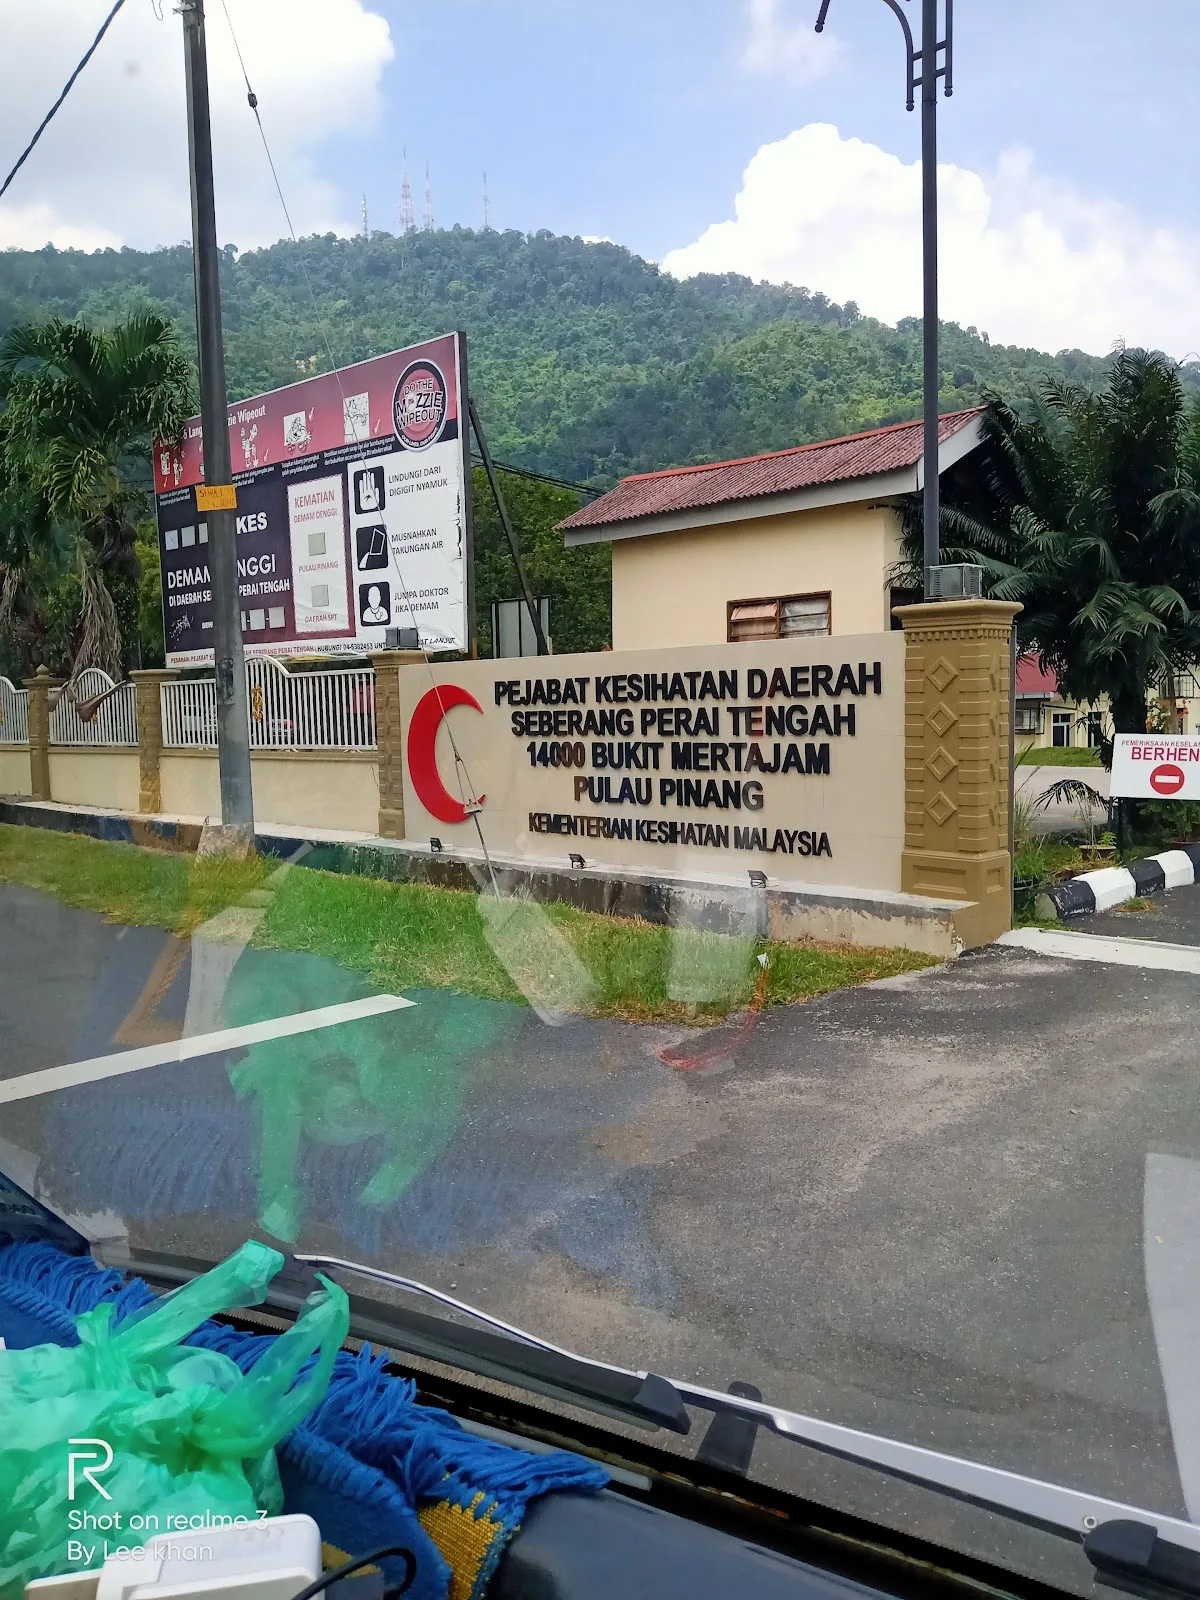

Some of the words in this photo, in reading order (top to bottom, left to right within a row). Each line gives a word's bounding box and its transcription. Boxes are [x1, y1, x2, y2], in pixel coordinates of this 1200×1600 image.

[417, 378, 434, 390] THE
[238, 404, 266, 423] Wipeout
[396, 408, 442, 429] WIPEOUT
[389, 470, 422, 484] LINDUNGI
[424, 466, 440, 476] DARI
[390, 484, 414, 496] DIGIGIT
[416, 478, 448, 492] NYAMUK
[294, 490, 334, 508] KEMATIAN
[236, 512, 268, 534] KES
[294, 512, 315, 523] DEMAM
[316, 508, 338, 519] DENGGI
[392, 528, 436, 542] MUSNAHKAN
[392, 543, 430, 556] TAKUNGAN
[432, 541, 444, 550] AIR
[237, 554, 276, 577] NGGI
[298, 564, 316, 573] PULAU
[318, 561, 338, 572] PINANG
[239, 582, 258, 596] PERAI
[260, 579, 290, 595] TENGAH
[394, 590, 418, 600] JUMPA
[420, 587, 448, 598] DOKTOR
[169, 596, 176, 607] DI
[176, 591, 202, 606] DAERAH
[395, 604, 408, 613] JIKA
[410, 602, 438, 612] DEMAM
[304, 614, 327, 623] DAERAH
[374, 642, 386, 650] UNT
[494, 677, 590, 706] PEJABAT
[595, 670, 738, 703] KESIHATAN
[747, 662, 882, 699] DAERAH
[512, 708, 634, 737] SEBERANG
[640, 706, 719, 737] PERAI
[727, 704, 856, 737] TENGAH
[526, 742, 586, 768] 14000
[592, 742, 664, 770] BUKIT
[671, 742, 830, 775] MERTAJAM
[1132, 747, 1200, 762] BERHEN
[574, 776, 652, 805] PULAU
[660, 778, 764, 811] PINANG
[529, 812, 632, 841] KEMENTERIAN
[636, 814, 729, 848] KESIHATAN
[734, 826, 833, 858] MALAYSIA
